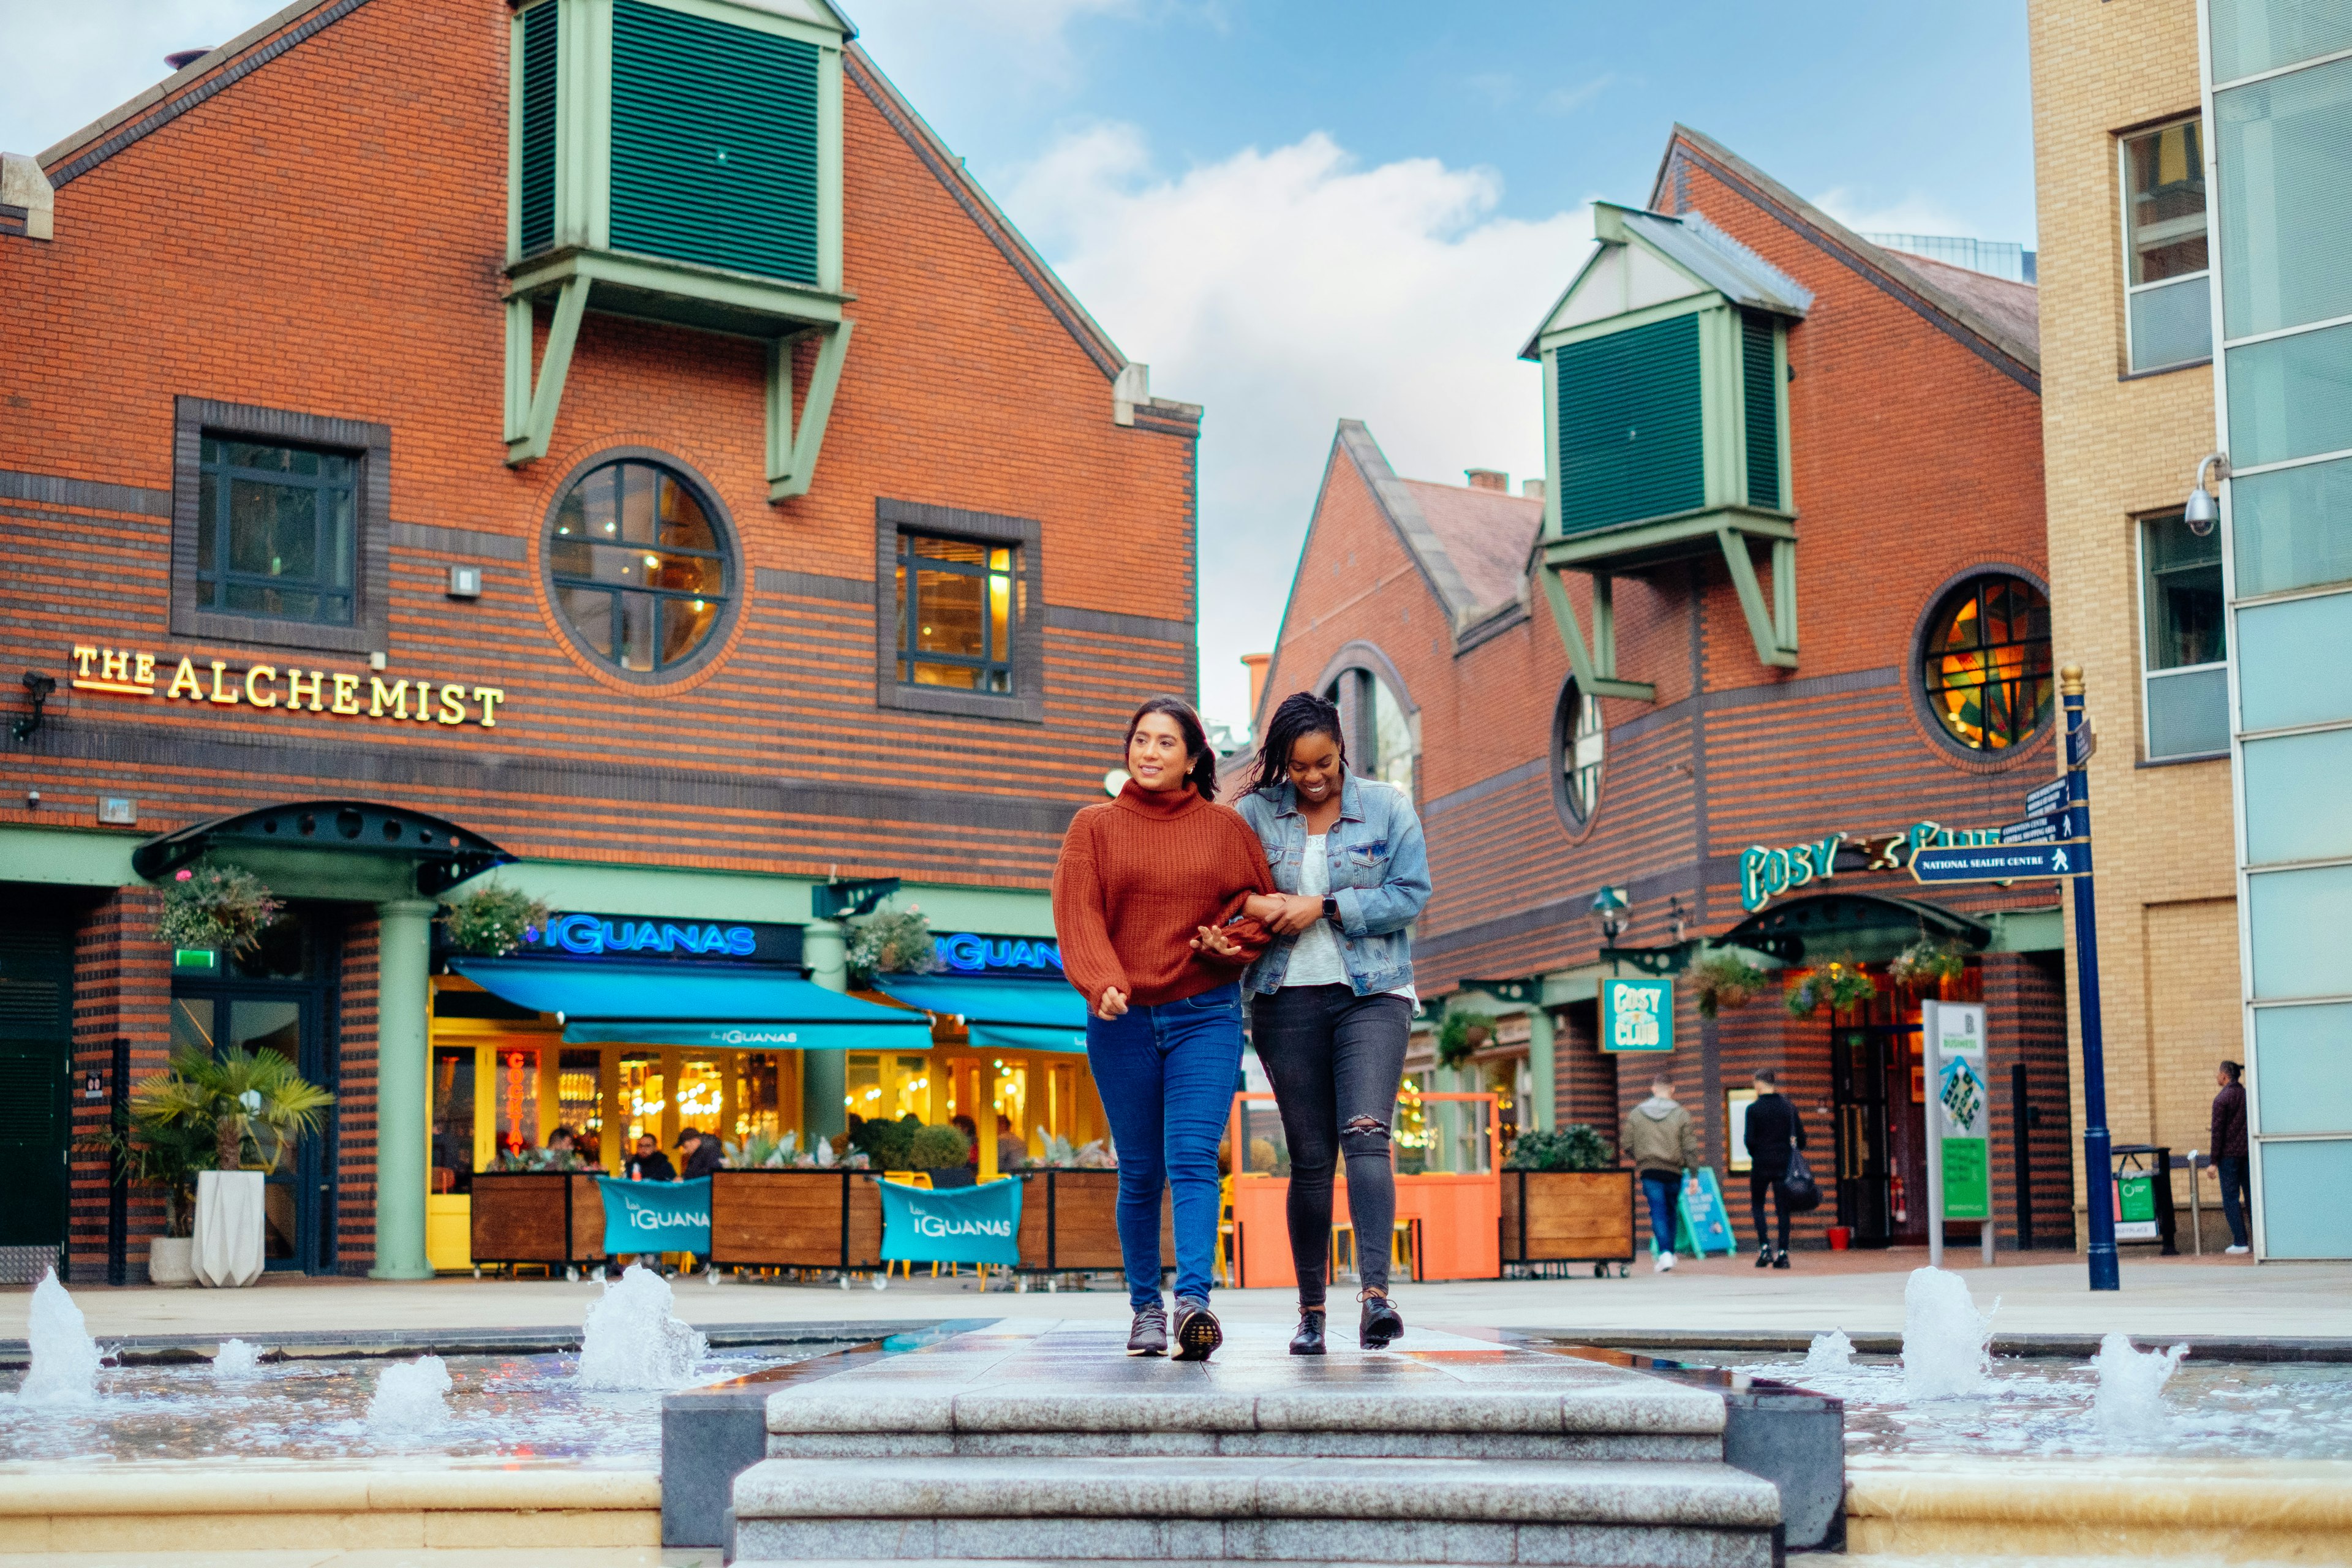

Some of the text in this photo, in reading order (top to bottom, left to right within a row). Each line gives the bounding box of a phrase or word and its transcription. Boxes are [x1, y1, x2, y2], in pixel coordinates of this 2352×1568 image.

[74, 646, 504, 727] THE ALCHEMIST
[1740, 831, 1847, 913] COSY
[1923, 856, 2044, 870] NATIONAL SEALIFE CENTRE
[545, 914, 756, 956] IGUANAS
[1613, 984, 1661, 1014] COSY
[722, 1030, 797, 1044] IGUANAS
[1615, 1022, 1659, 1046] CLUB
[507, 1052, 524, 1159] COCKTAI
[630, 1209, 710, 1230] IGUANA
[914, 1215, 1011, 1237] IGUANAS
